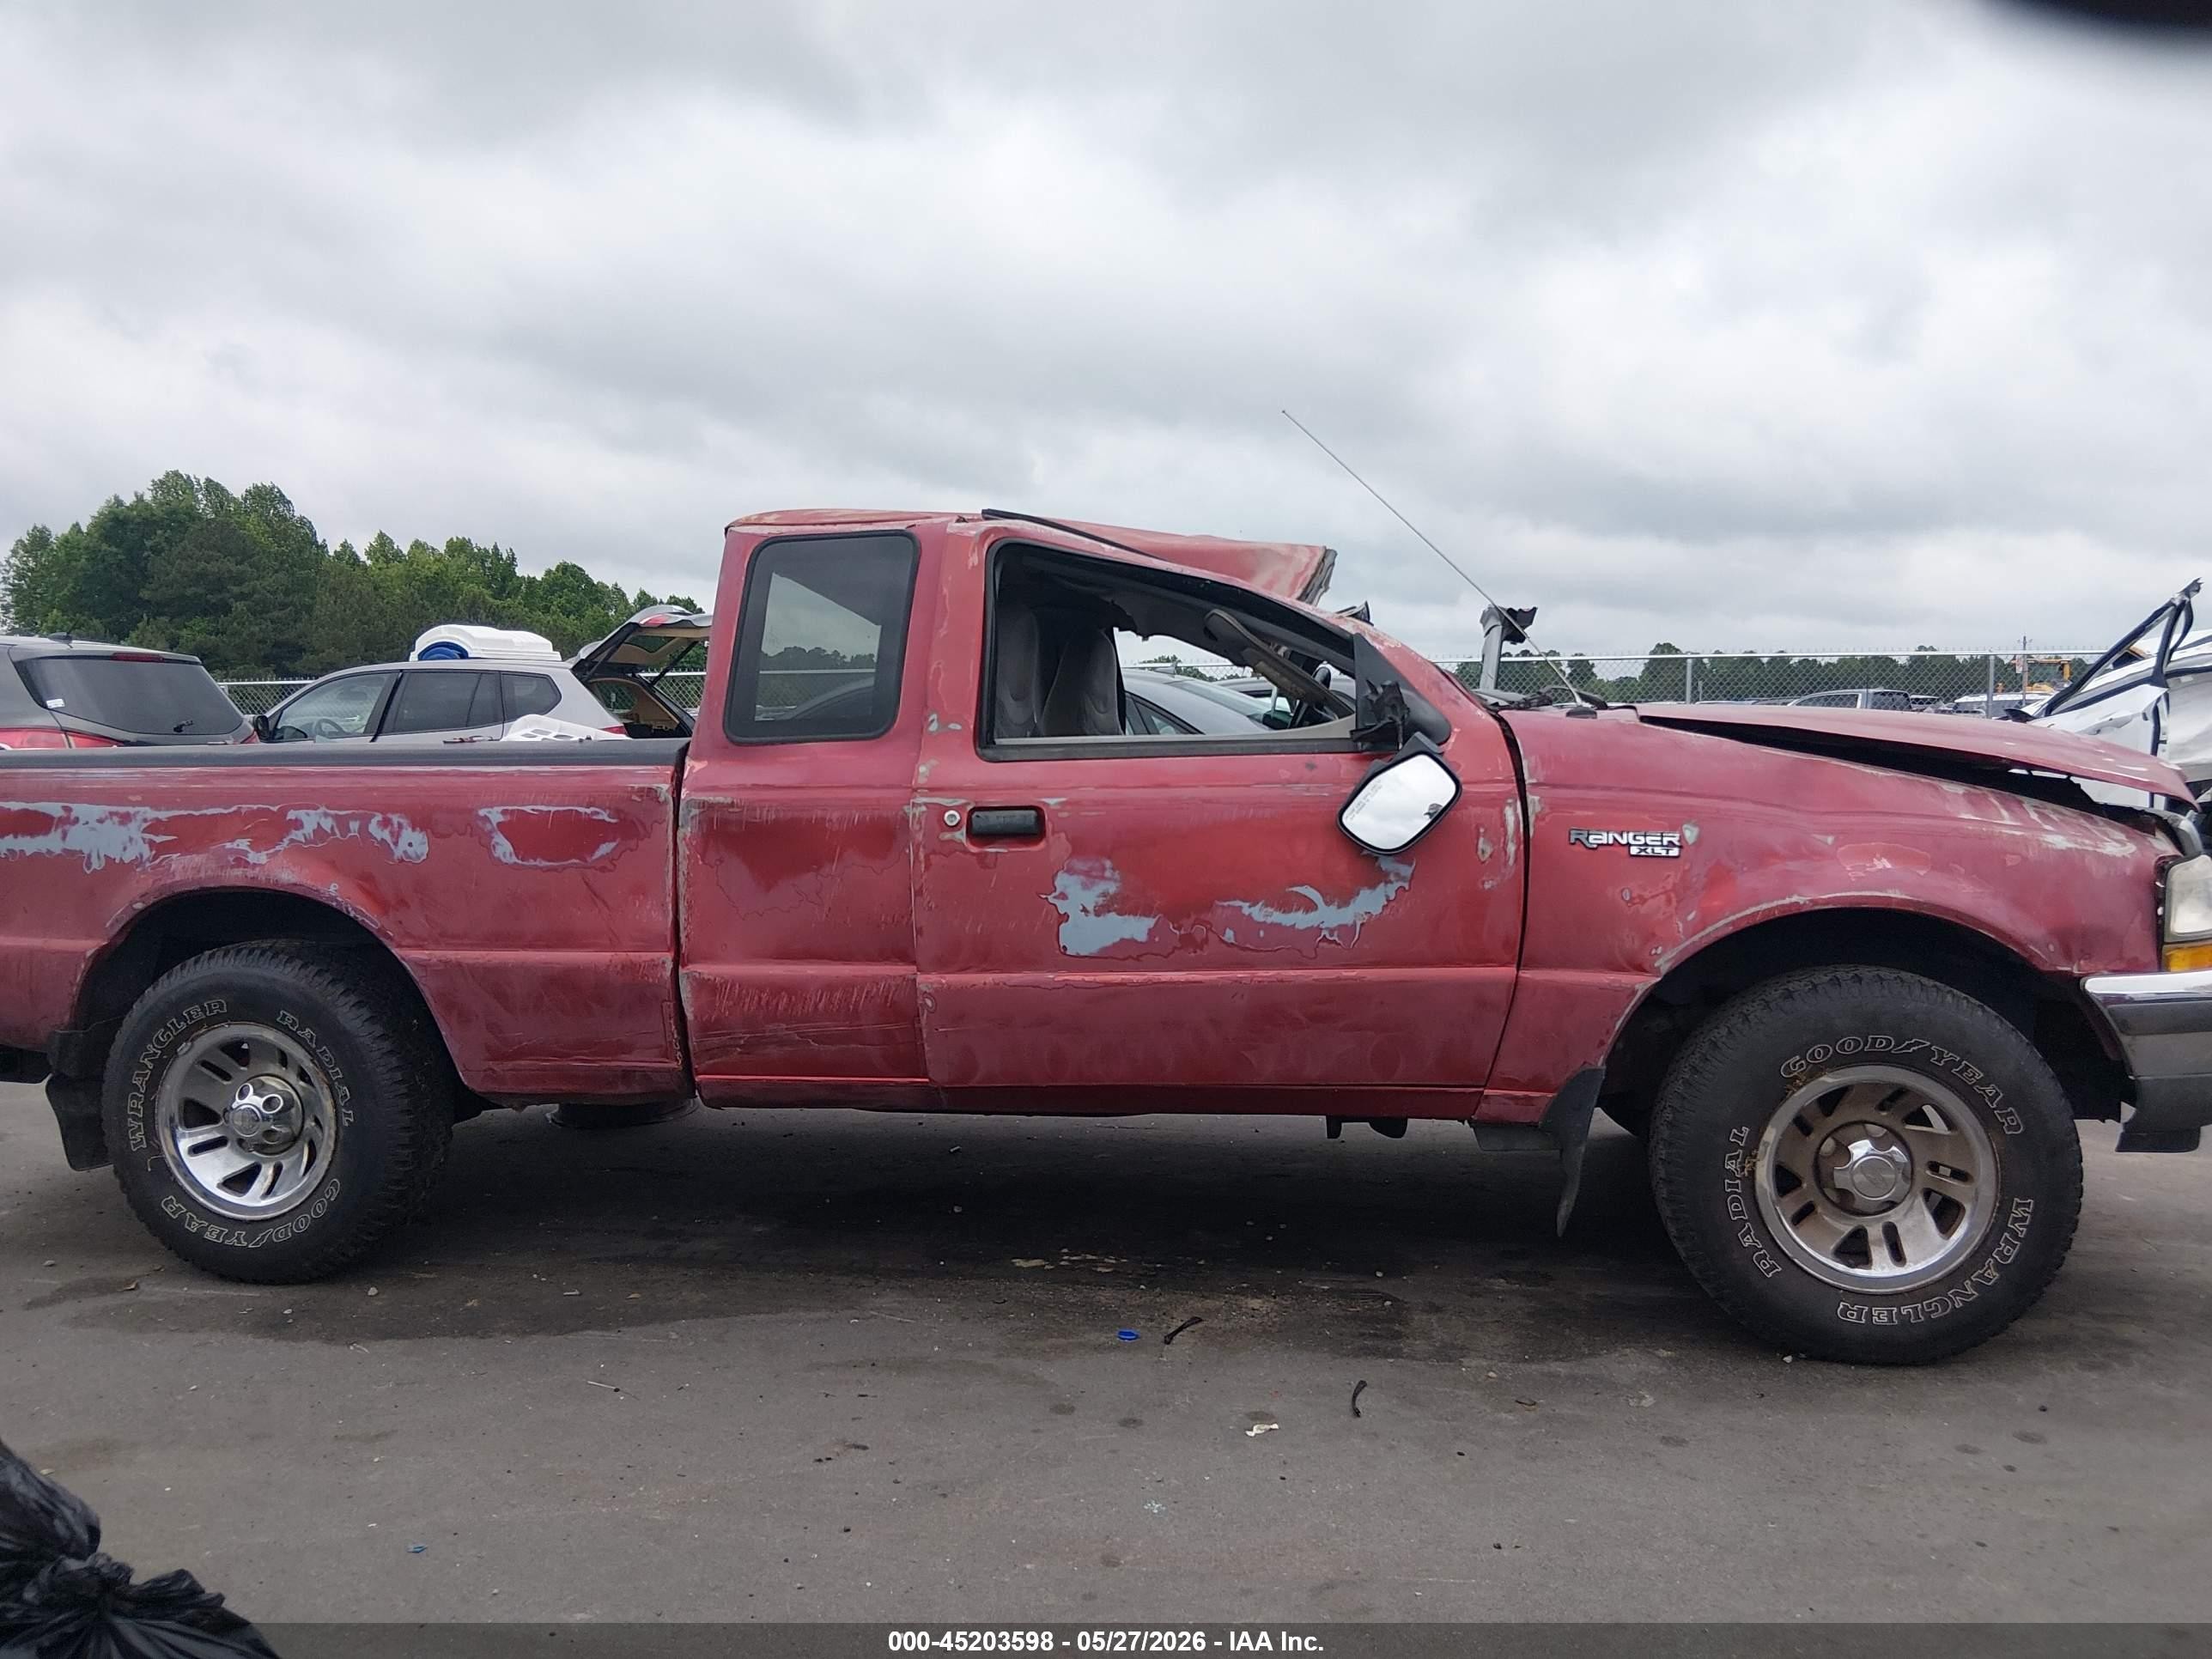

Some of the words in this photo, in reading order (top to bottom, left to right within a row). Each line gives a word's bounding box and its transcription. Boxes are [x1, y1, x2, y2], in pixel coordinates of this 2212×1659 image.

[1569, 829, 1681, 849] RANGER
[1634, 847, 1676, 856] XLT
[126, 999, 228, 1151] WRANGLER
[276, 1010, 356, 1127] RADIAL
[1780, 1035, 2025, 1135] GOODYEAR
[1723, 1124, 1783, 1279] RADIAL
[1837, 1197, 2033, 1325] WRANGLER
